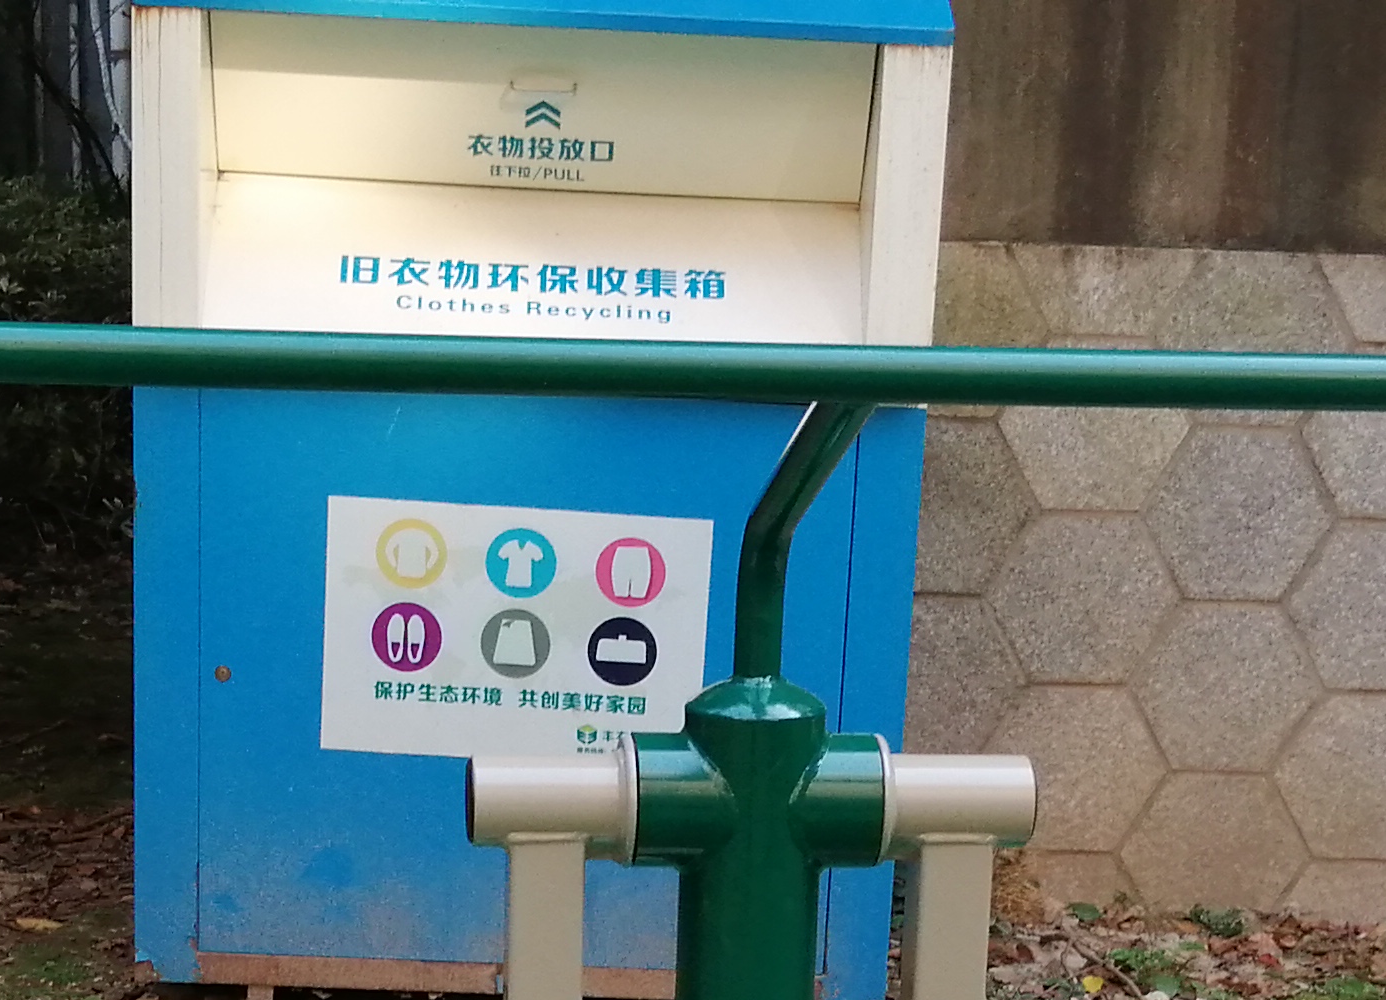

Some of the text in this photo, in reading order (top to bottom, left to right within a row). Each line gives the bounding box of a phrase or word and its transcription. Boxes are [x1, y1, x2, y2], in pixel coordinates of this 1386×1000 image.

[467, 134, 615, 162] 衣物投放口
[340, 255, 726, 300] 旧衣物环保收集箱
[396, 295, 672, 324] Clothes Recycling
[374, 681, 647, 715] 保护生态环境 共创美好家园
